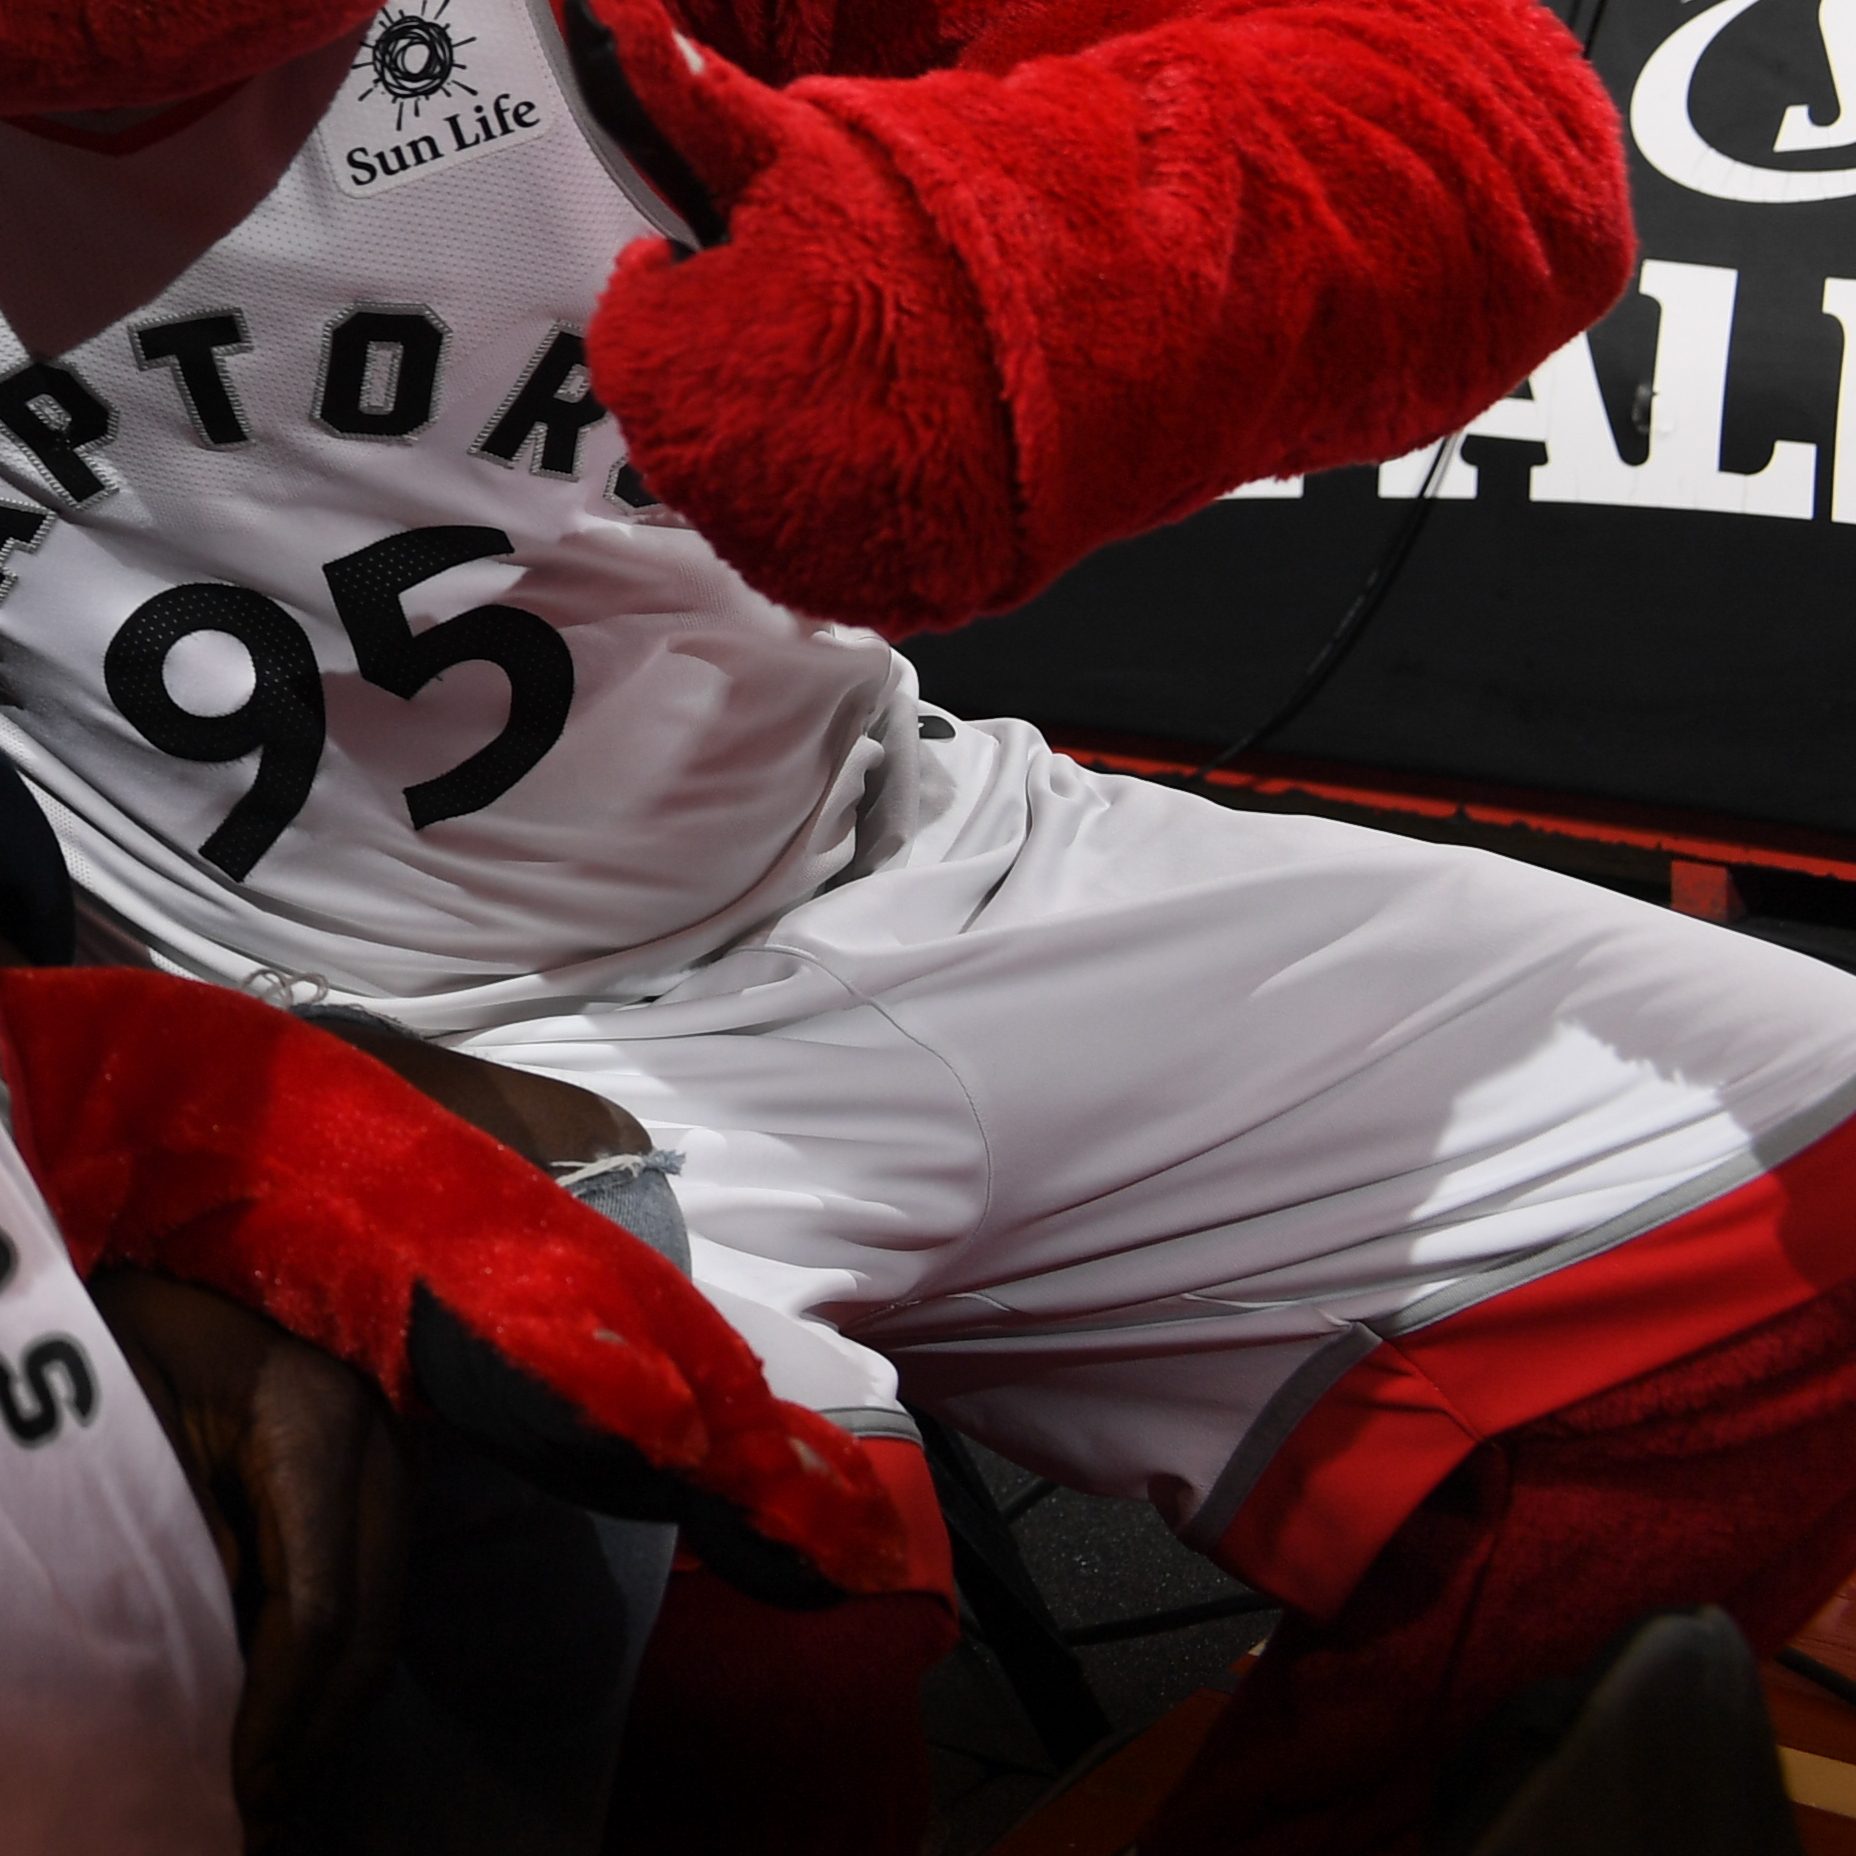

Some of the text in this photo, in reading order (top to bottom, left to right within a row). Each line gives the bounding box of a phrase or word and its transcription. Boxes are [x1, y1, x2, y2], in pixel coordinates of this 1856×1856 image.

[346, 93, 541, 186] Sun Life
[104, 524, 574, 883] 95
